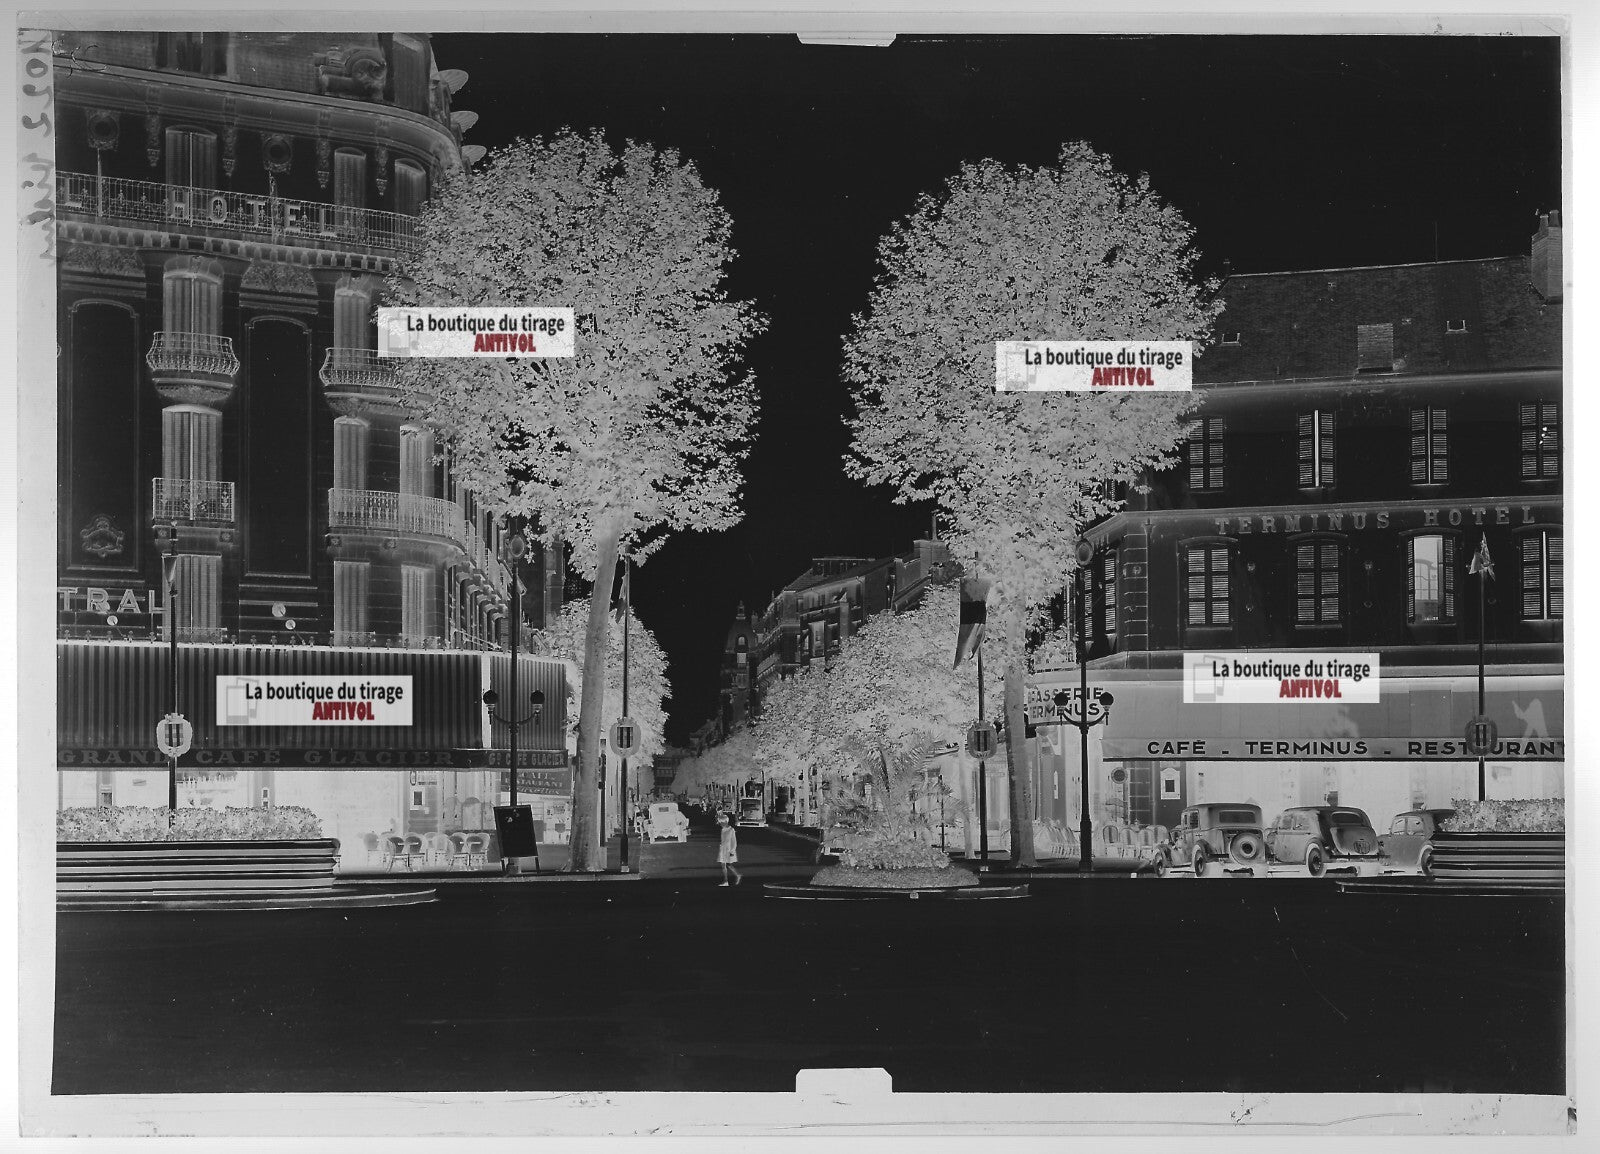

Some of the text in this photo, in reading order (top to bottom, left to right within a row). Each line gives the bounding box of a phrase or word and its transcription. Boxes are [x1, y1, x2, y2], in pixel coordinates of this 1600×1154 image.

[169, 187, 338, 238] HOTEL
[1214, 505, 1536, 535] TERMINUS HOTEL
[57, 586, 168, 614] TRAL
[303, 750, 454, 765] GLACIER
[1147, 740, 1206, 755] CAFÉ
[1245, 741, 1368, 755] TERMINUS
[1408, 741, 1564, 755] RESTURANT
[531, 752, 565, 766] GLACIER
